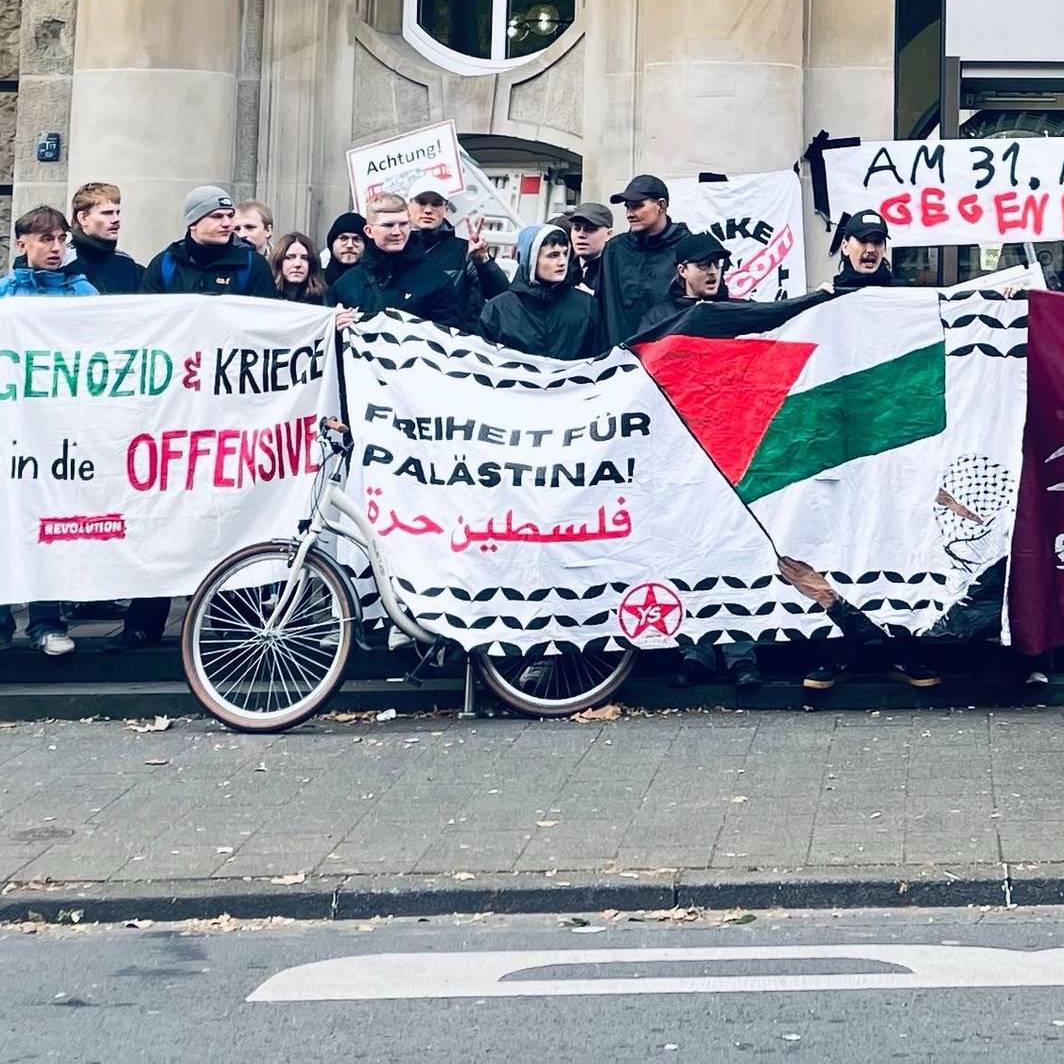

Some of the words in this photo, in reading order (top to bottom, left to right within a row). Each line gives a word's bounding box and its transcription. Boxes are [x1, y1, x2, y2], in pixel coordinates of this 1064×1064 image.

[366, 139, 443, 176] Achtung!
[863, 144, 945, 188] AM
[969, 142, 1041, 190] 31.
[880, 188, 1050, 235] GEGEN
[0, 346, 174, 401] GENOZID
[213, 338, 324, 396] KRIEGE
[364, 402, 554, 448] FREIHEIT
[562, 411, 651, 447] FÜR
[10, 439, 38, 480] in
[51, 438, 95, 481] die
[127, 414, 322, 492] OFFENSIVE
[362, 443, 636, 488] PALÄSTINA!
[44, 520, 122, 536] REVOLUTION
[366, 486, 445, 537] حرة
[450, 496, 633, 553] فلسطين
[636, 605, 662, 626] YS
